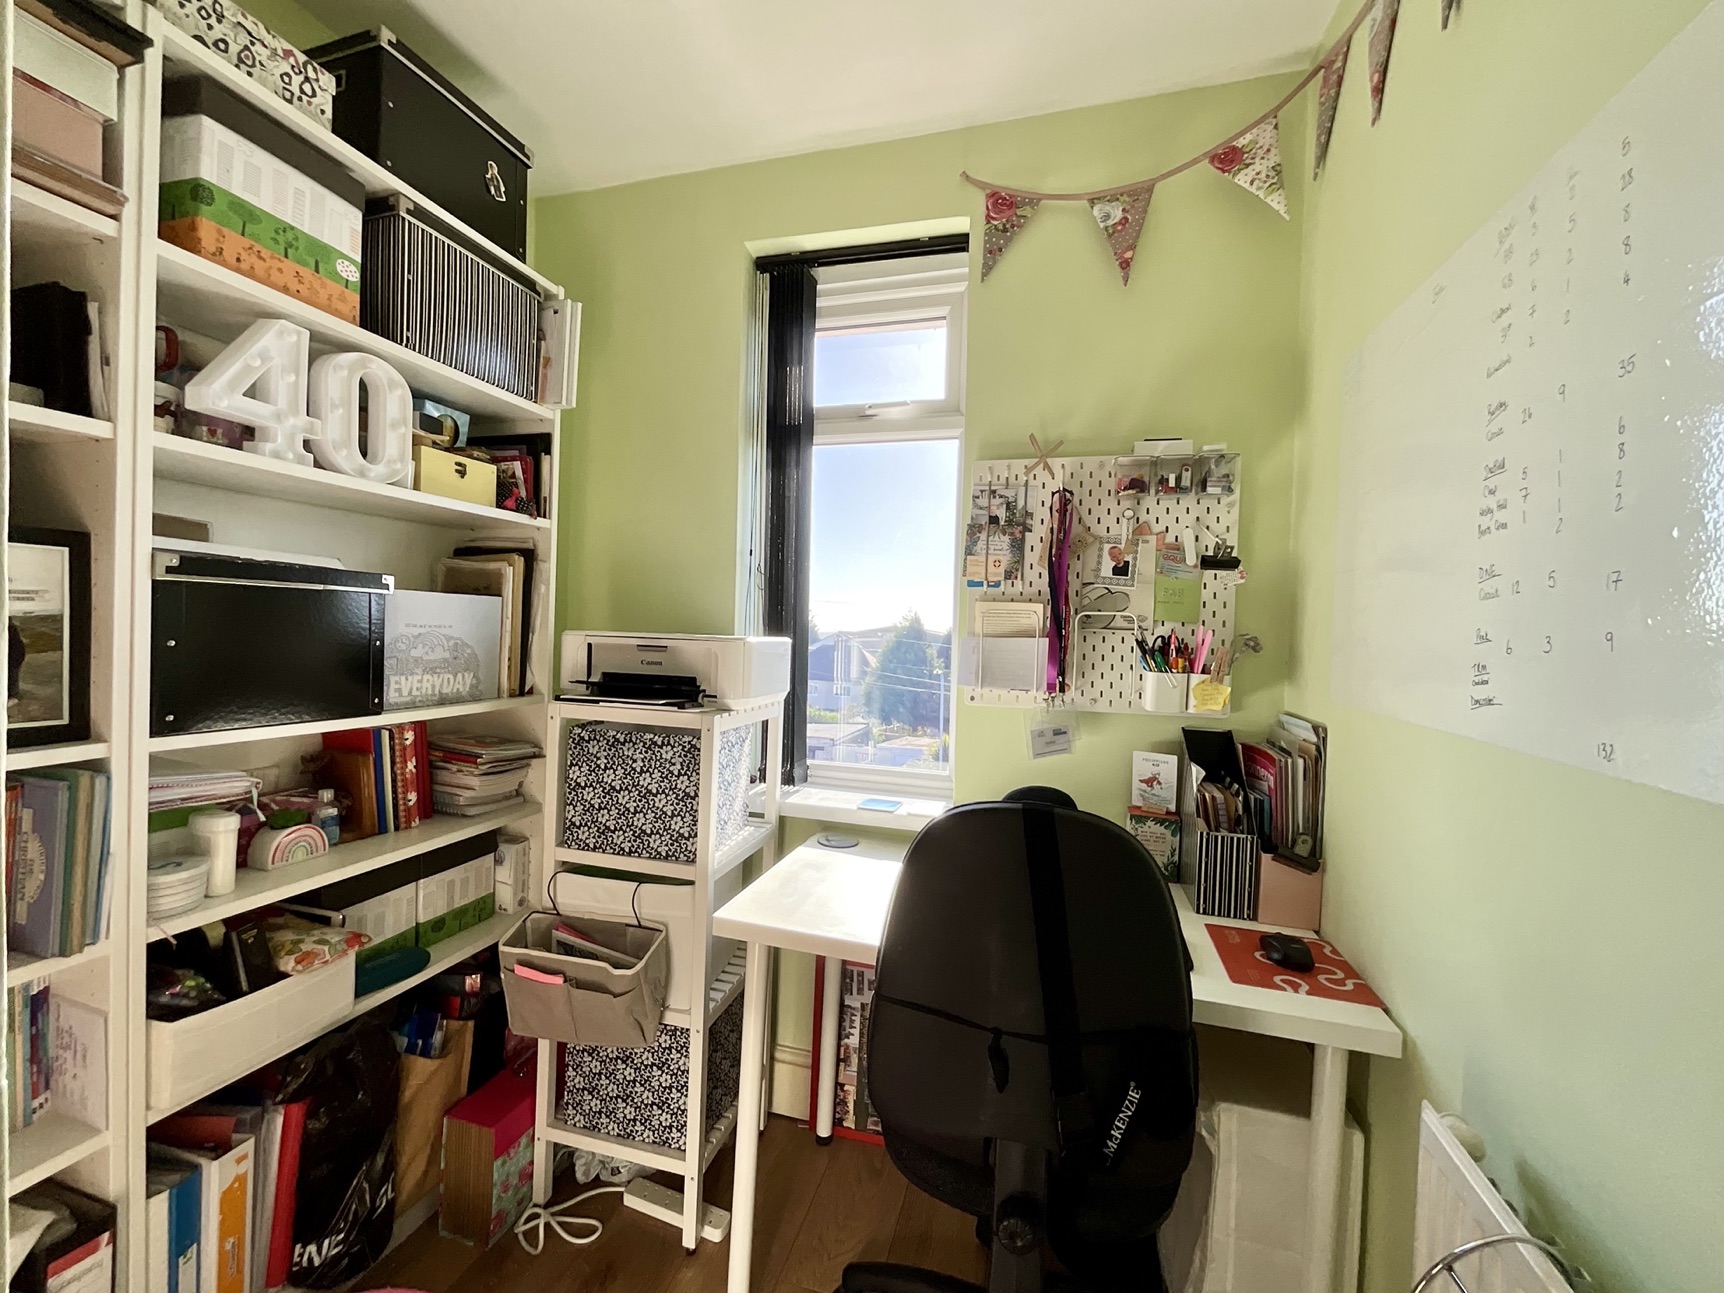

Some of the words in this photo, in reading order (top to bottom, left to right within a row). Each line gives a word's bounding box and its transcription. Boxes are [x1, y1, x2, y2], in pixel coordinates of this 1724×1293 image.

[1621, 135, 1631, 158] 5
[1622, 234, 1632, 256] 8
[1617, 353, 1637, 378] 35
[184, 318, 414, 485] 40
[1558, 383, 1566, 403] 9
[1618, 415, 1626, 435] 6
[1617, 441, 1626, 460] 8
[1615, 469, 1623, 488] 2
[1518, 486, 1531, 504] 7
[1614, 493, 1624, 513] 2
[1555, 517, 1564, 535] 2
[1511, 580, 1521, 597] 12
[1548, 569, 1556, 589] 5
[1606, 569, 1624, 592] 17
[1505, 639, 1513, 655] 6
[1542, 635, 1552, 654] 3
[1605, 631, 1614, 652] 9
[640, 658, 663, 666] Canon
[388, 671, 474, 698] EVERYDAY
[1597, 742, 1615, 763] 132
[1102, 1084, 1142, 1157] McKENZIE
